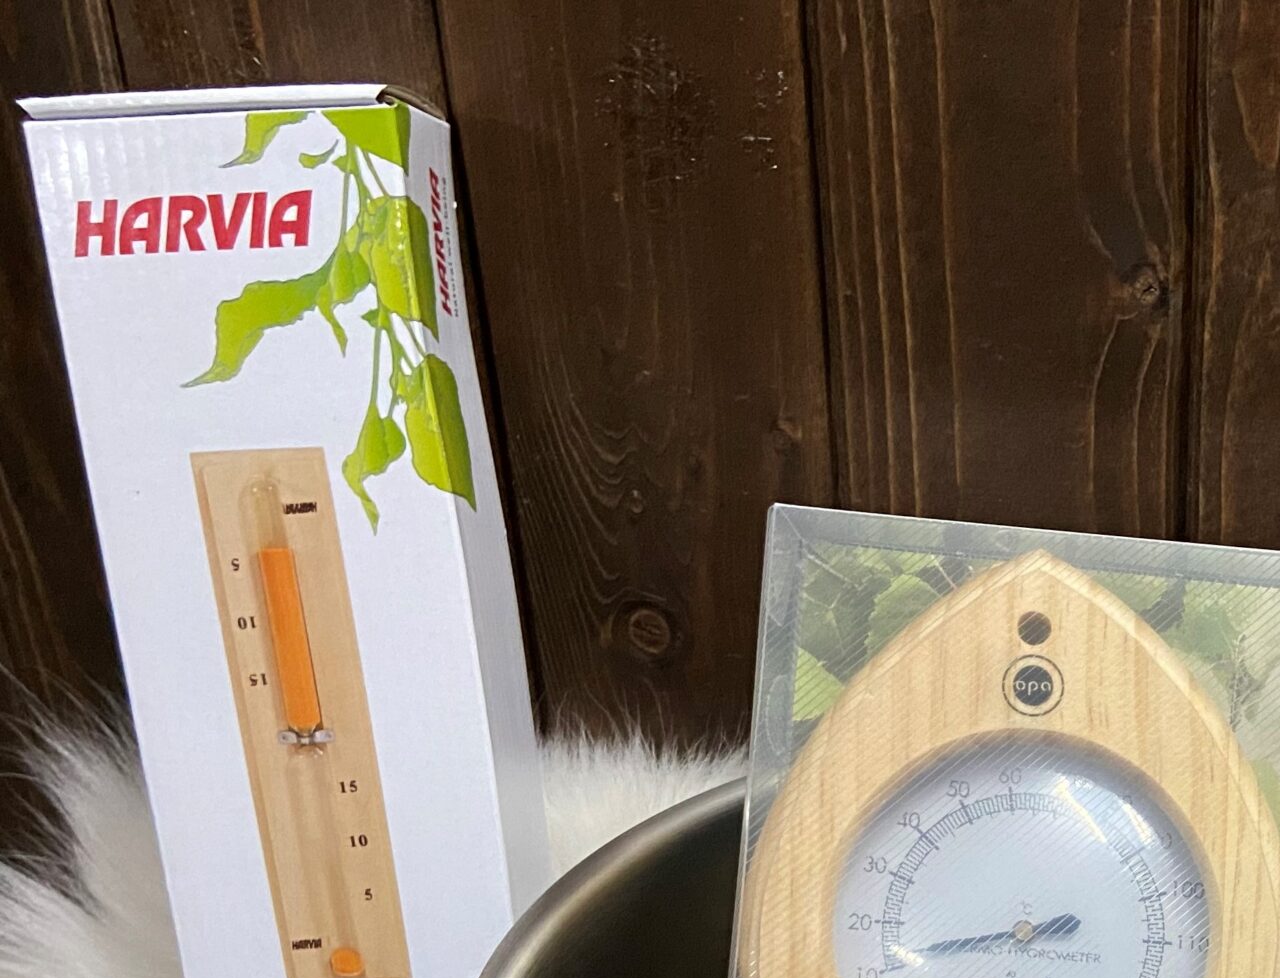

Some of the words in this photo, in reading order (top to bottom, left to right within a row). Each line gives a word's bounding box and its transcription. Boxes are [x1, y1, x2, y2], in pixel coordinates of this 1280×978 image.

[74, 190, 313, 258] HARVIA
[429, 167, 452, 316] HARVIA
[1015, 680, 1051, 696] opa
[999, 767, 1022, 785] 60
[339, 780, 358, 794] 15
[946, 780, 970, 799] 50
[897, 812, 921, 829] 40
[350, 834, 369, 848] 10
[863, 856, 888, 875] 30
[364, 888, 373, 901] 5
[848, 913, 872, 931] 20
